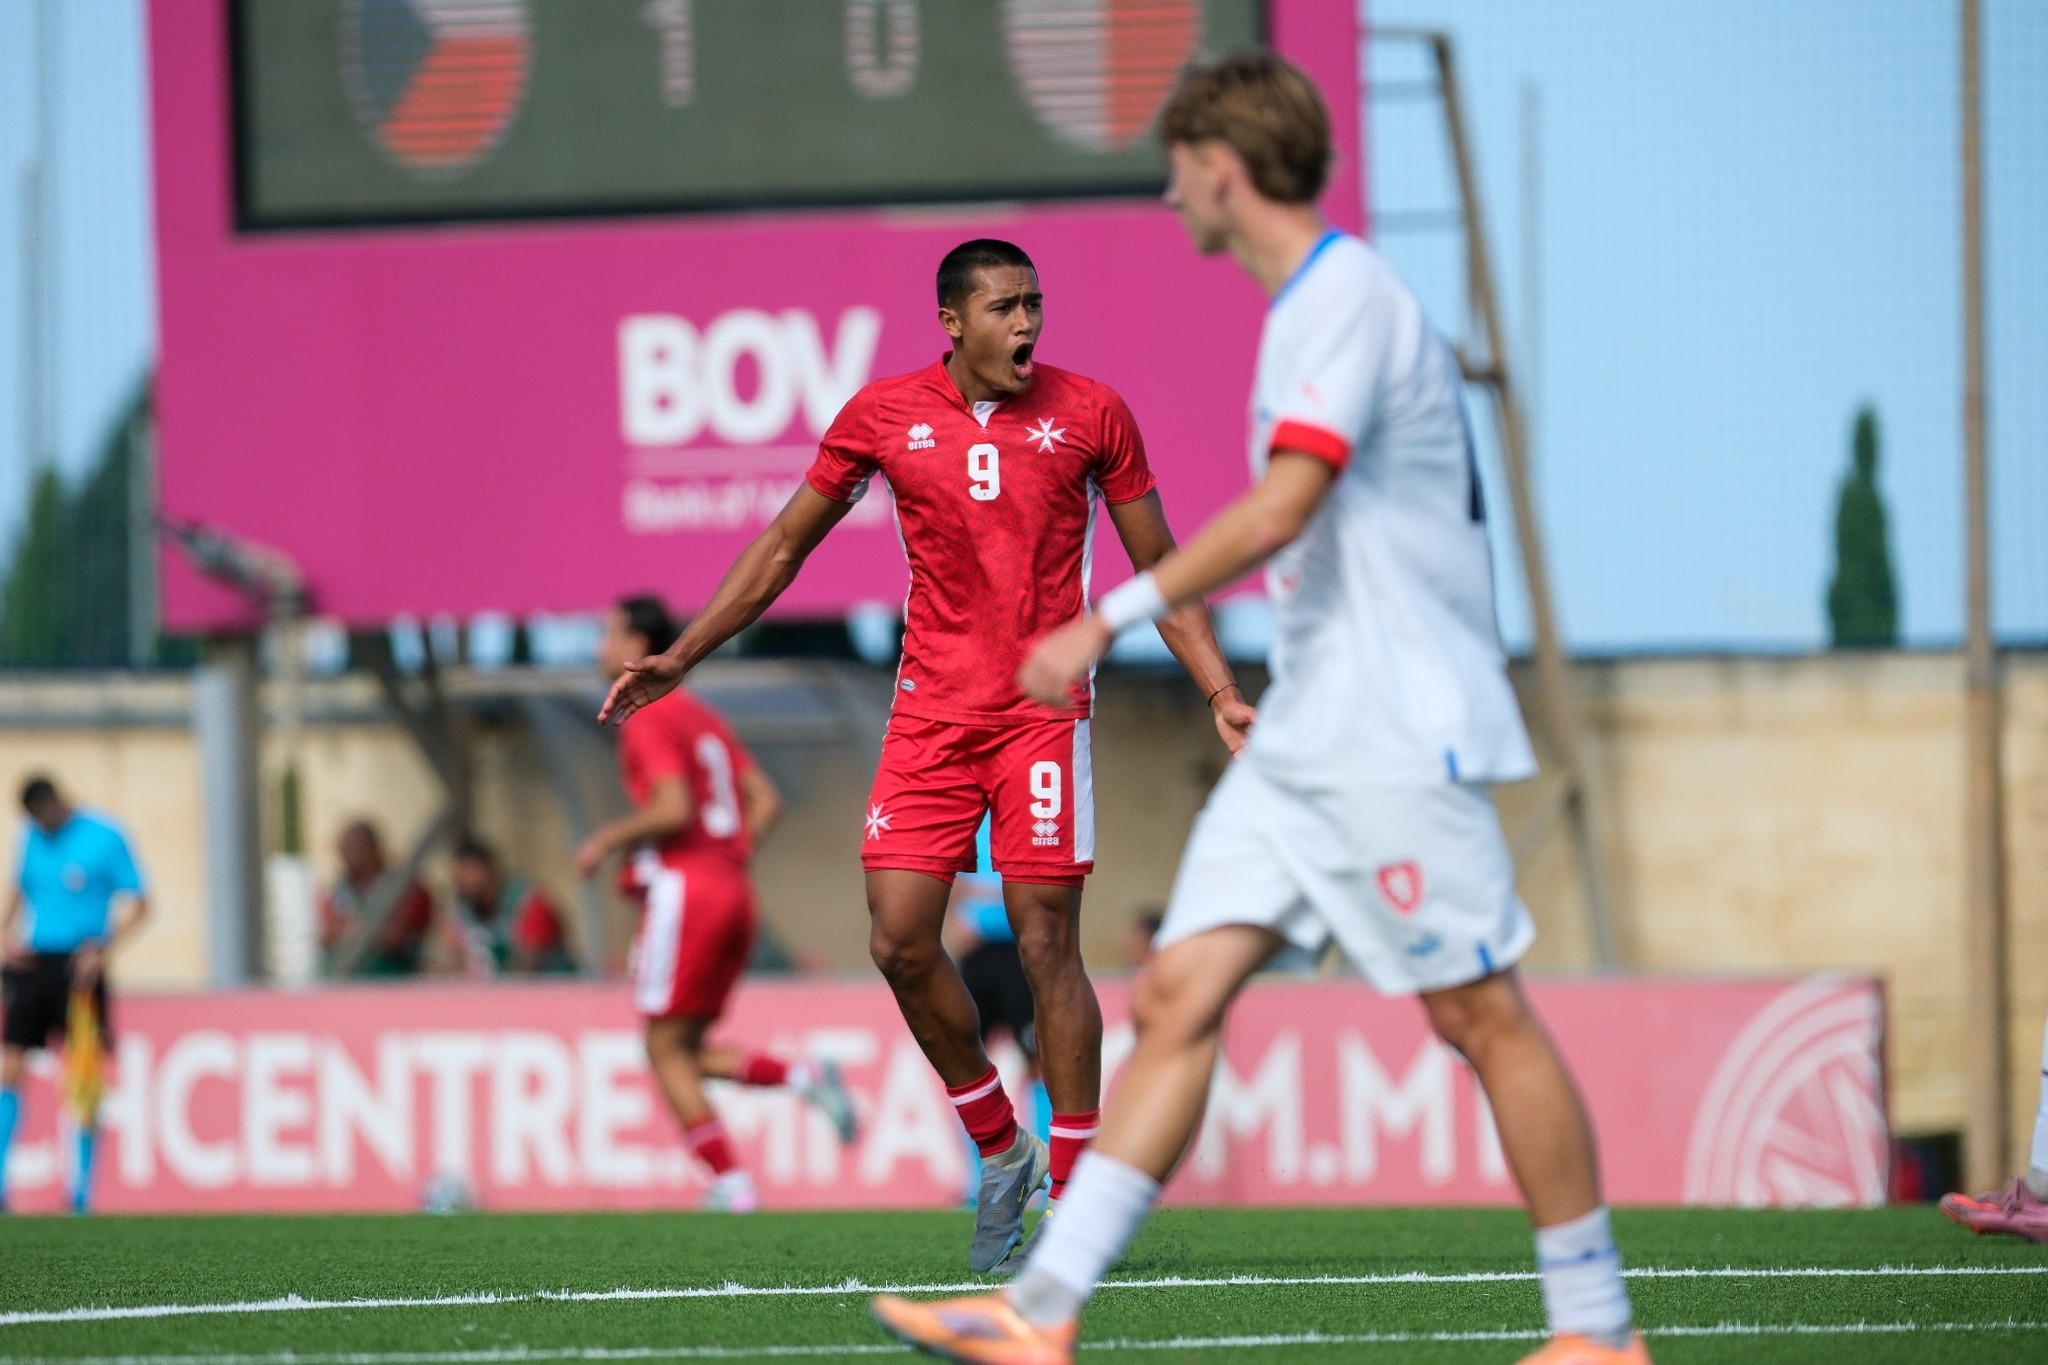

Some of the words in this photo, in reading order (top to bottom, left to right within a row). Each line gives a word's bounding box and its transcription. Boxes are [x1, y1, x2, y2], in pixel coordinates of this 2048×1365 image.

[641, 0, 694, 106] 1
[617, 305, 881, 447] BOV
[967, 443, 1000, 500] 9
[1030, 761, 1061, 818] 9
